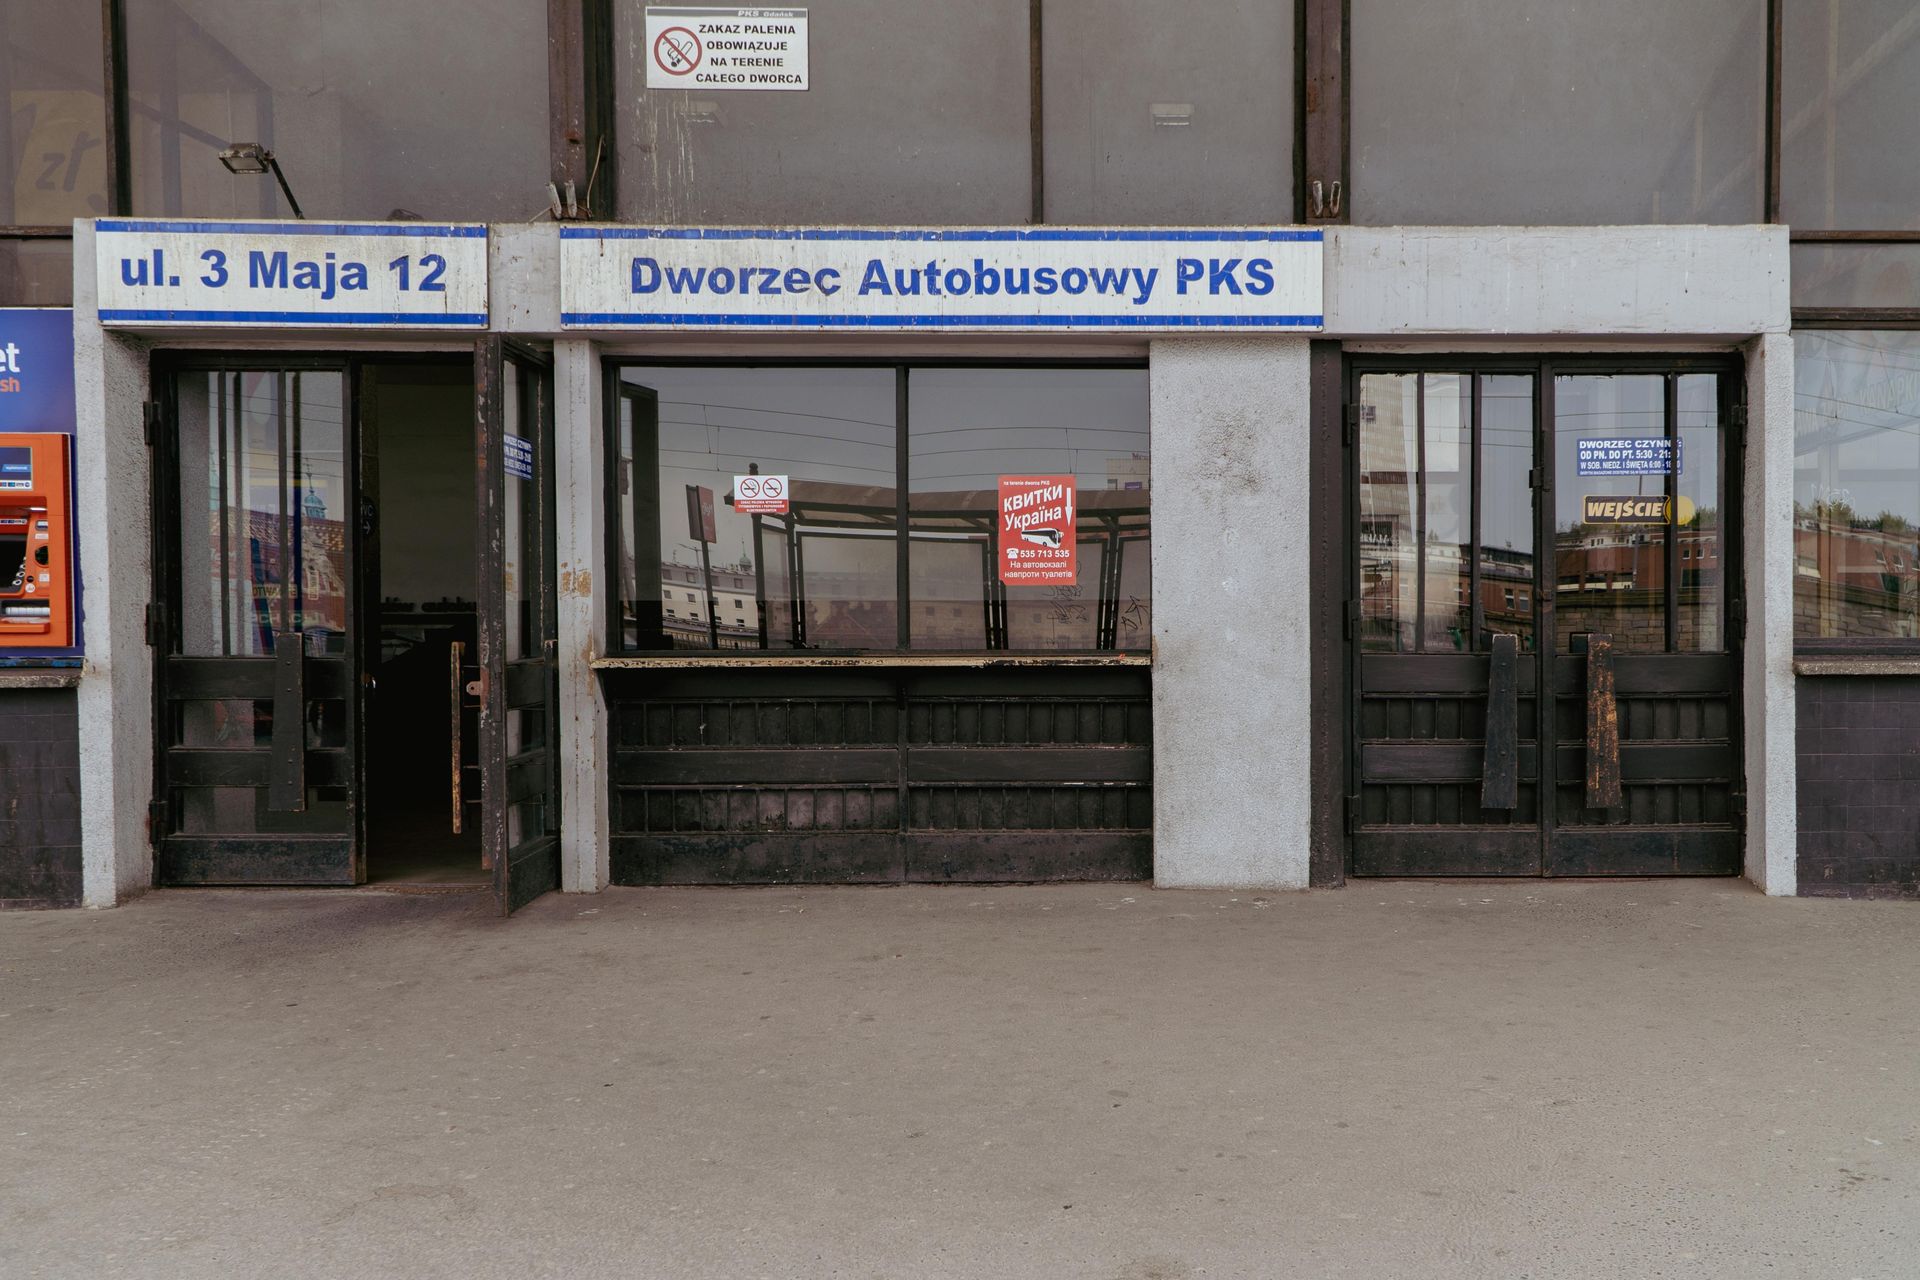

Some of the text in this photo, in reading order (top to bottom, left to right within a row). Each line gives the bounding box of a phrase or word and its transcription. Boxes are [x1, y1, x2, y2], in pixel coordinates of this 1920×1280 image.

[698, 24, 796, 35] ZAKAZ PALENIA
[706, 41, 788, 53] OBOWIĄZUJE
[710, 57, 784, 67] NA TERENIE
[696, 73, 803, 84] CAŁEGO DWORCA
[120, 249, 447, 301] ul. 3 Maja 12
[630, 256, 1275, 306] Dworzec Autobusowy PKS
[1579, 439, 1682, 449] DWORZEC CZYNN:
[1580, 450, 1591, 460] OD
[1593, 450, 1607, 460] PN.
[1608, 450, 1621, 460] DO
[1622, 450, 1635, 459] PT.
[1636, 450, 1653, 459] 5:30
[1580, 461, 1587, 470] W
[1587, 461, 1602, 470] SOB.
[1625, 459, 1649, 470] ŚWIĘTA
[1003, 484, 1063, 513] КВИТКИ
[1587, 500, 1664, 520] WEJŚCIE
[1004, 505, 1062, 532] Україна
[1020, 549, 1070, 558] 535 713 535
[1010, 560, 1067, 568] На автовокзалі
[1004, 570, 1073, 579] навпроти туалетів
